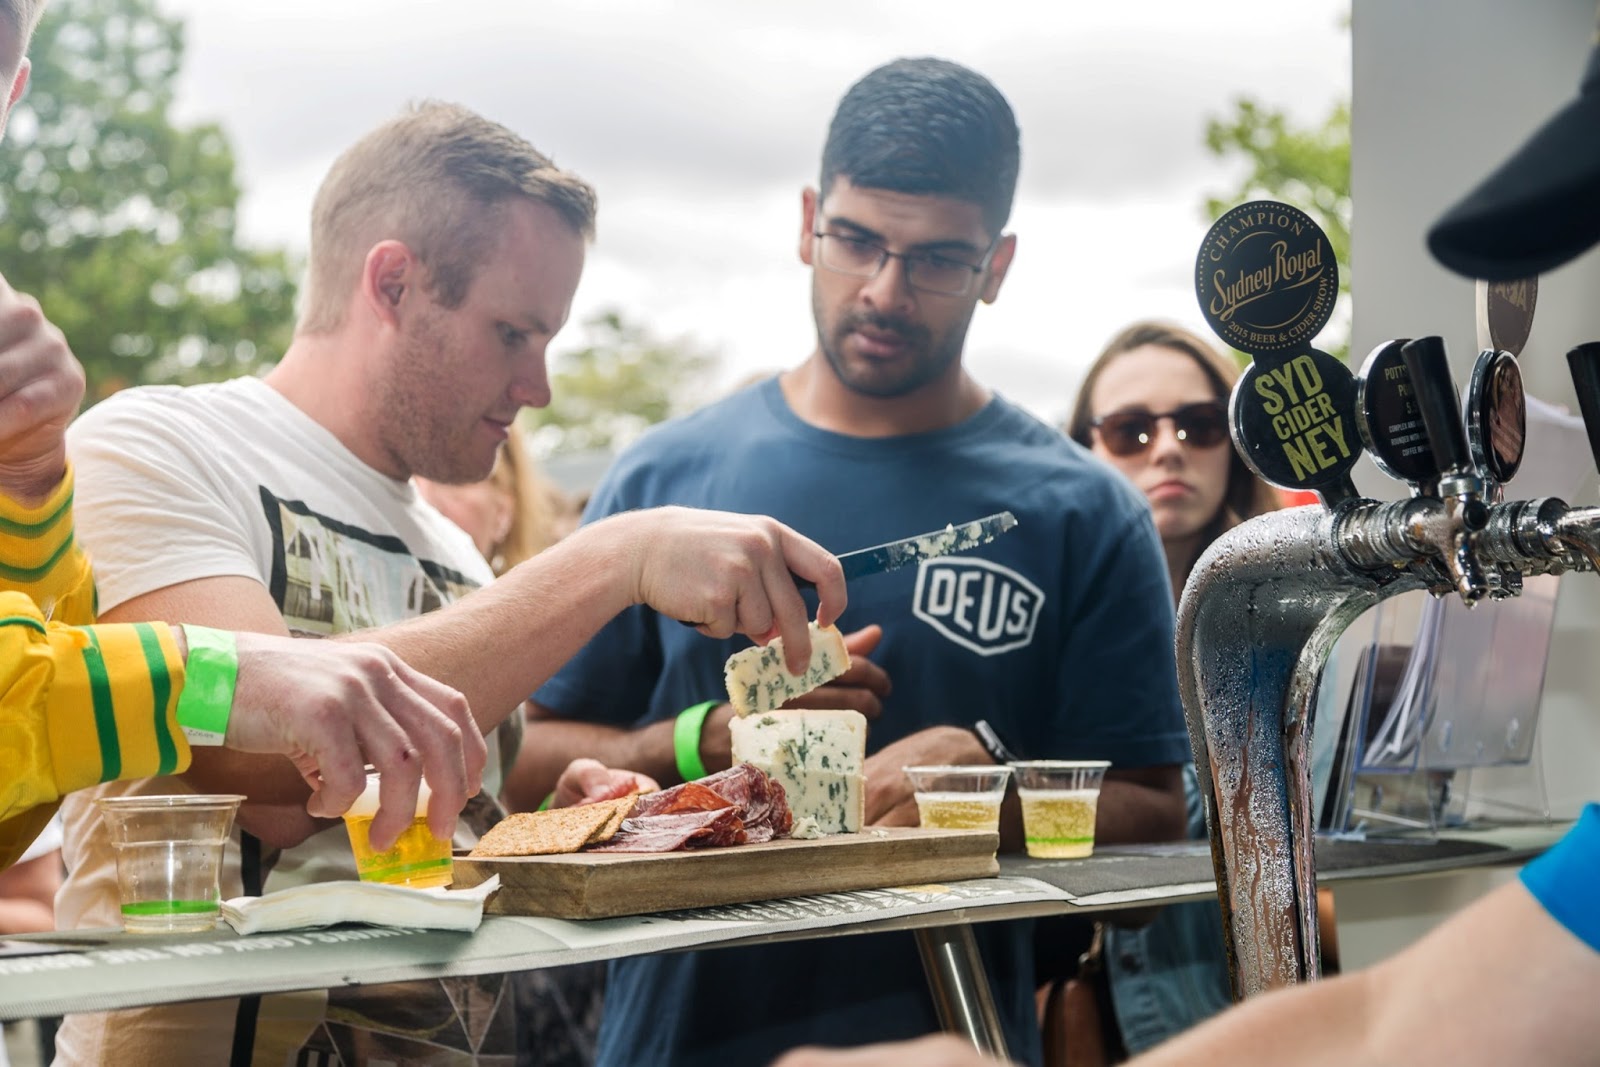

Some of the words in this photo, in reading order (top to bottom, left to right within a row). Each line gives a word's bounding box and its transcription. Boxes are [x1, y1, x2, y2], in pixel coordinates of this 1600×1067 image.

[1210, 212, 1304, 262] CHAMPION
[1210, 266, 1273, 321] Sydney
[1269, 238, 1322, 283] Royal
[1228, 320, 1248, 337] 2015
[1249, 331, 1277, 344] BEER
[1278, 332, 1288, 342] &
[1288, 311, 1318, 338] CIDER
[1312, 276, 1328, 312] SHOW
[1255, 354, 1324, 415] SYD
[1272, 392, 1337, 440] CIDER
[1281, 415, 1351, 482] NEY
[927, 568, 1030, 641] DEUS
